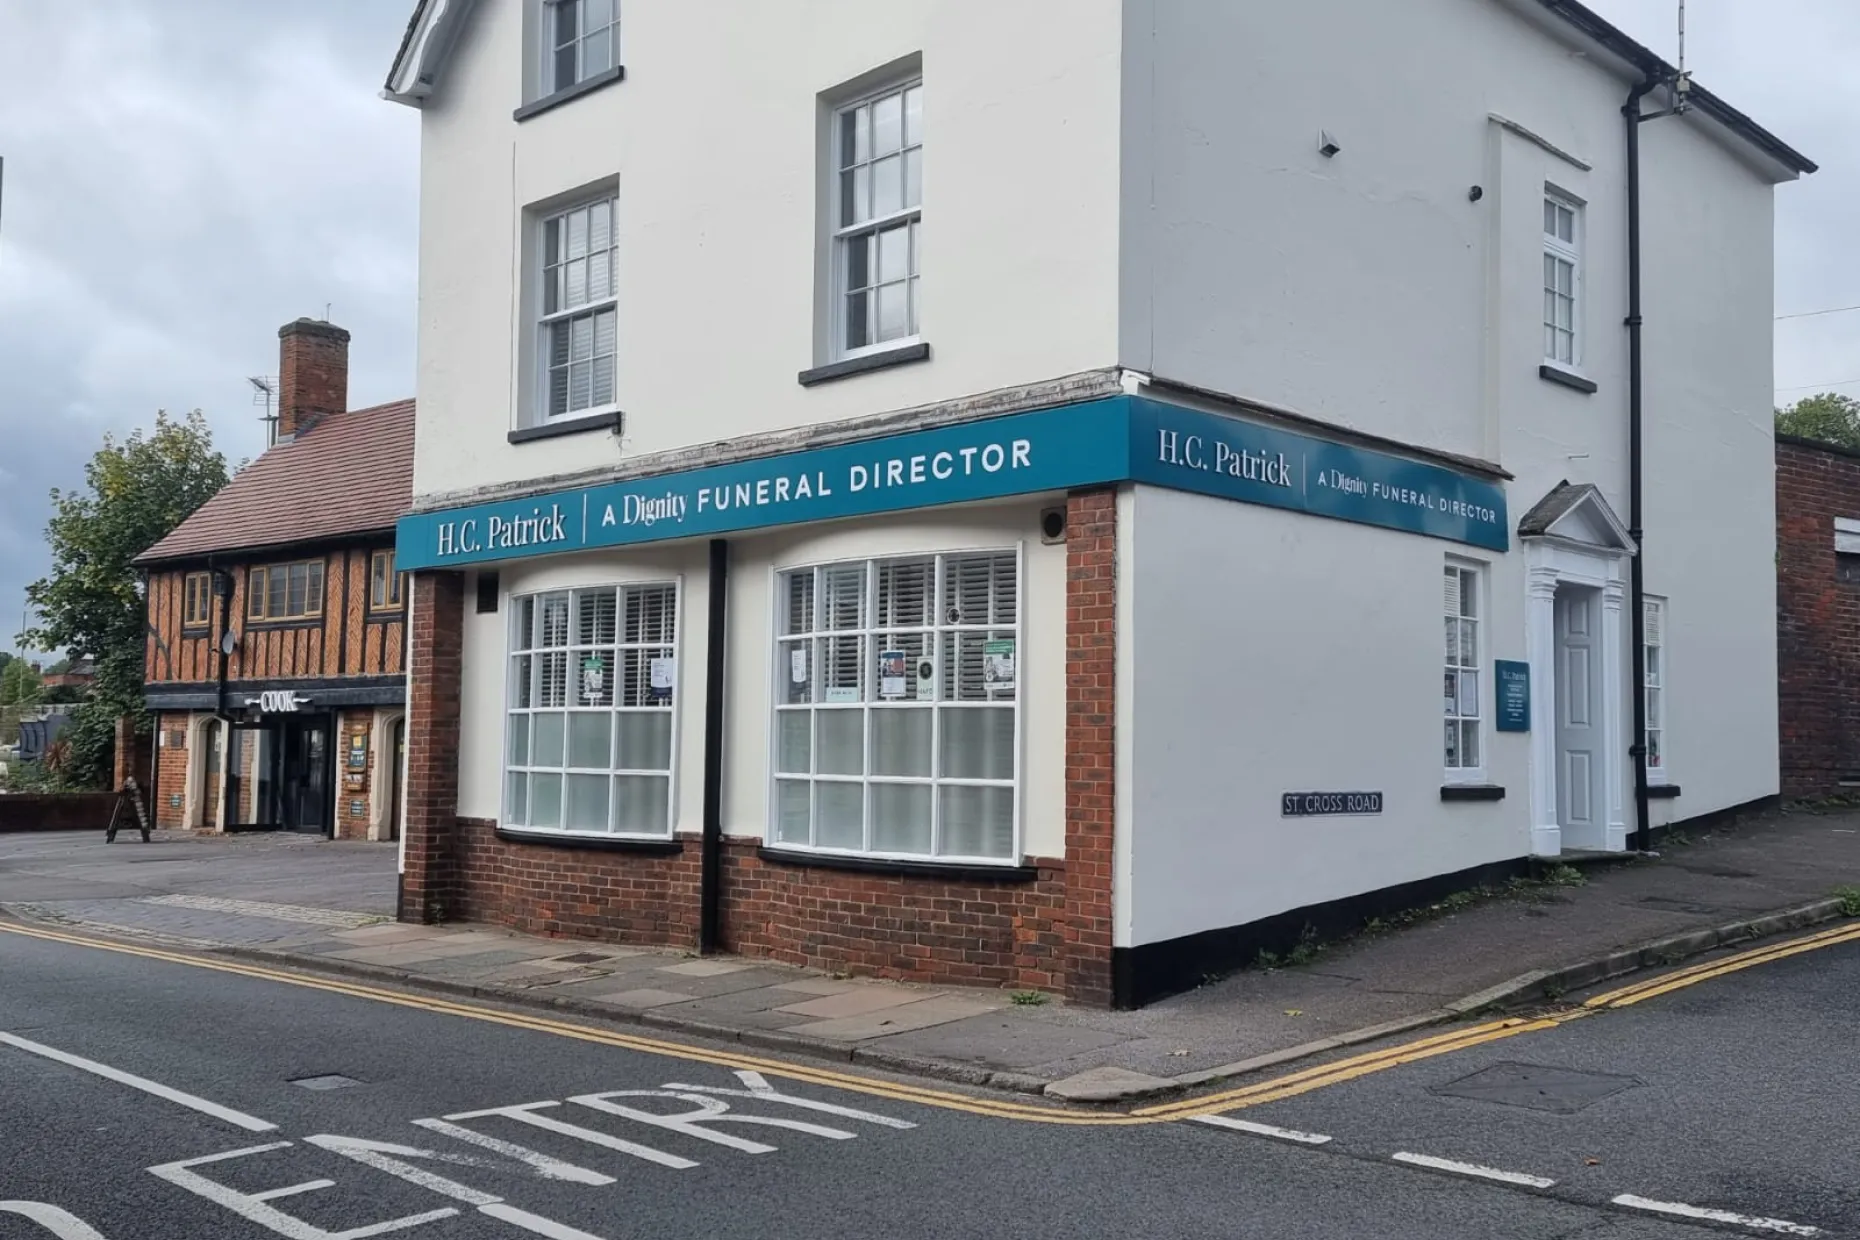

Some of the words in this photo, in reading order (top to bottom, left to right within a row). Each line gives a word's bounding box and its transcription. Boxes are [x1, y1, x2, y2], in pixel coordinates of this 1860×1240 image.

[437, 519, 481, 556] H.C.
[487, 503, 566, 549] Patrick
[601, 504, 616, 527] A
[622, 490, 689, 526] Dignity
[697, 471, 832, 513] FUNERAL
[850, 439, 1032, 493] DIRECTOR
[1158, 429, 1208, 470] H.C.
[1214, 441, 1292, 487] Patrick
[1317, 470, 1328, 487] A
[1331, 468, 1369, 499] Dignity
[1372, 482, 1434, 510] FUNERAL
[1439, 498, 1497, 525] DIRECTOR
[260, 690, 299, 712] COOK
[1305, 795, 1343, 812] CROSS
[1347, 795, 1379, 811] ROAD
[146, 1071, 918, 1240] ENTRY
